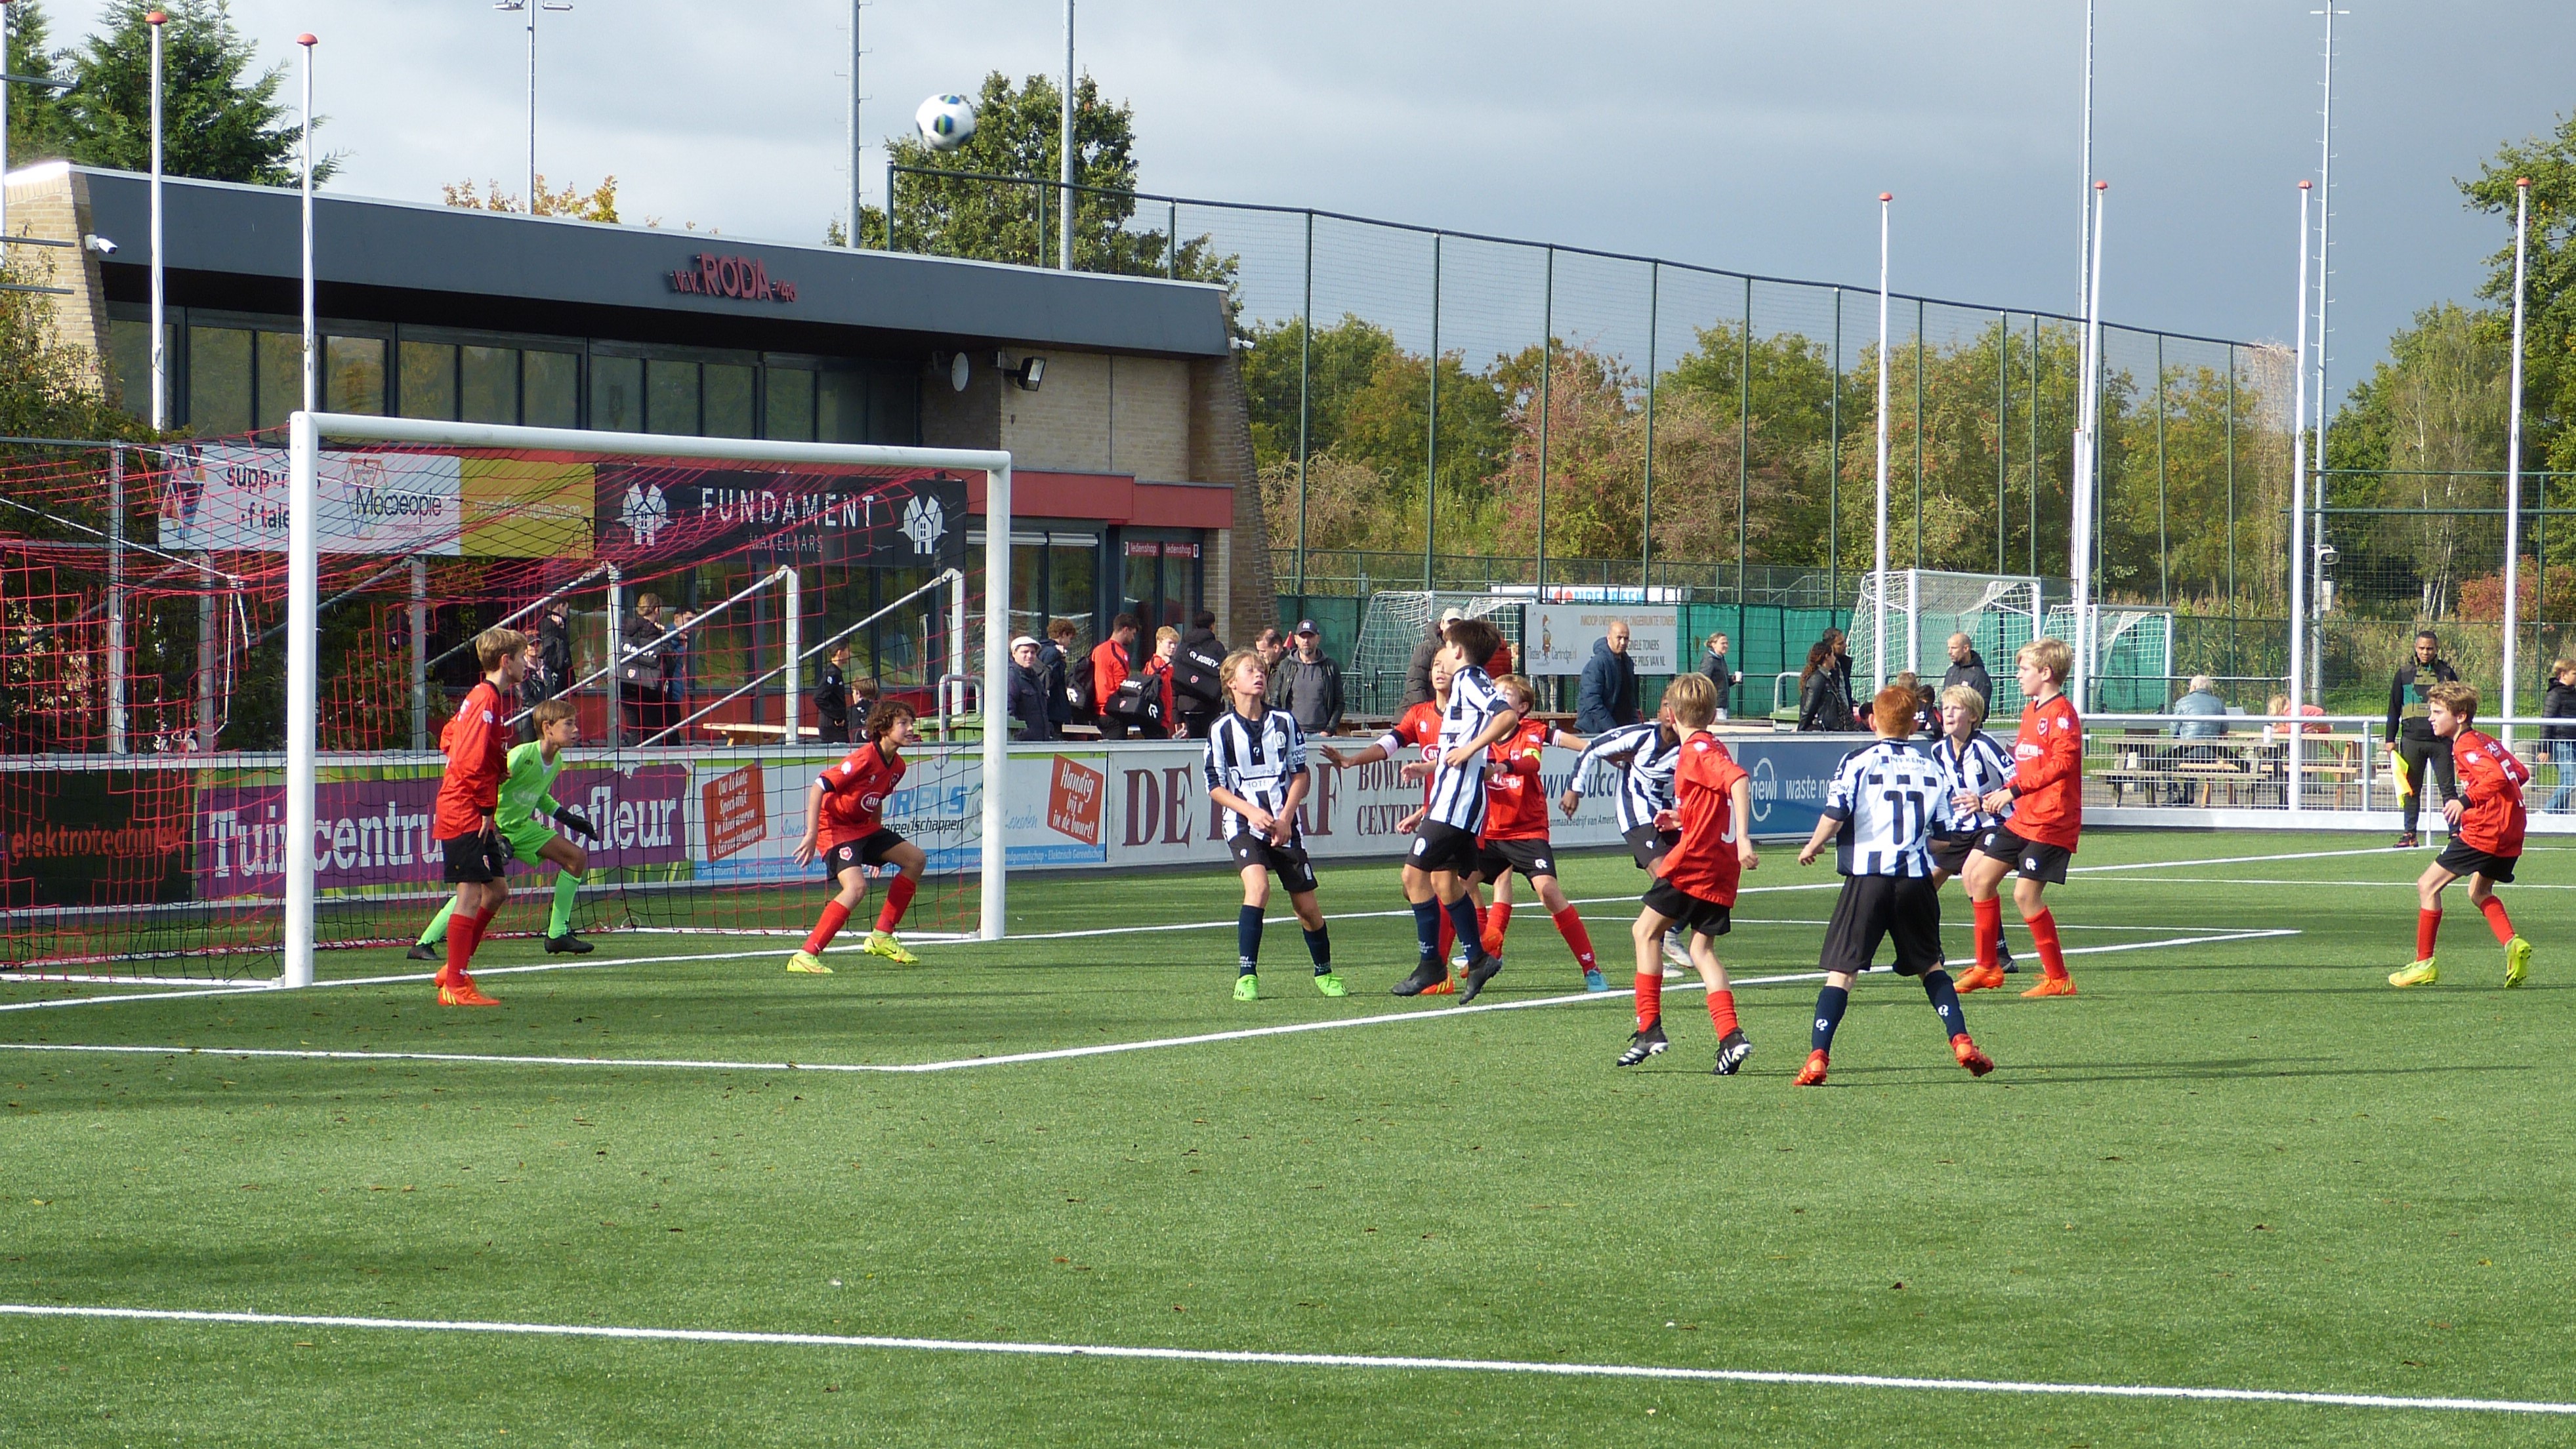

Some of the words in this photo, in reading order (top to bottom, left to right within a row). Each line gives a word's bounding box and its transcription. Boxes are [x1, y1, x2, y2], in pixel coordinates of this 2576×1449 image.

[700, 252, 773, 300] RODA
[702, 487, 874, 527] FUNDAMENT
[749, 532, 823, 552] MAKELAARS
[1131, 542, 1157, 556] ledenshop
[1165, 544, 1192, 557] ledenshop
[1060, 762, 1094, 803] Handig
[1786, 775, 1816, 800] waste
[1066, 792, 1078, 815] bij
[1077, 801, 1084, 815] u
[1122, 762, 1193, 848] DE
[1884, 790, 1925, 845] 11
[1053, 809, 1060, 827] in
[1062, 812, 1070, 830] de
[1071, 815, 1094, 840] buurt!
